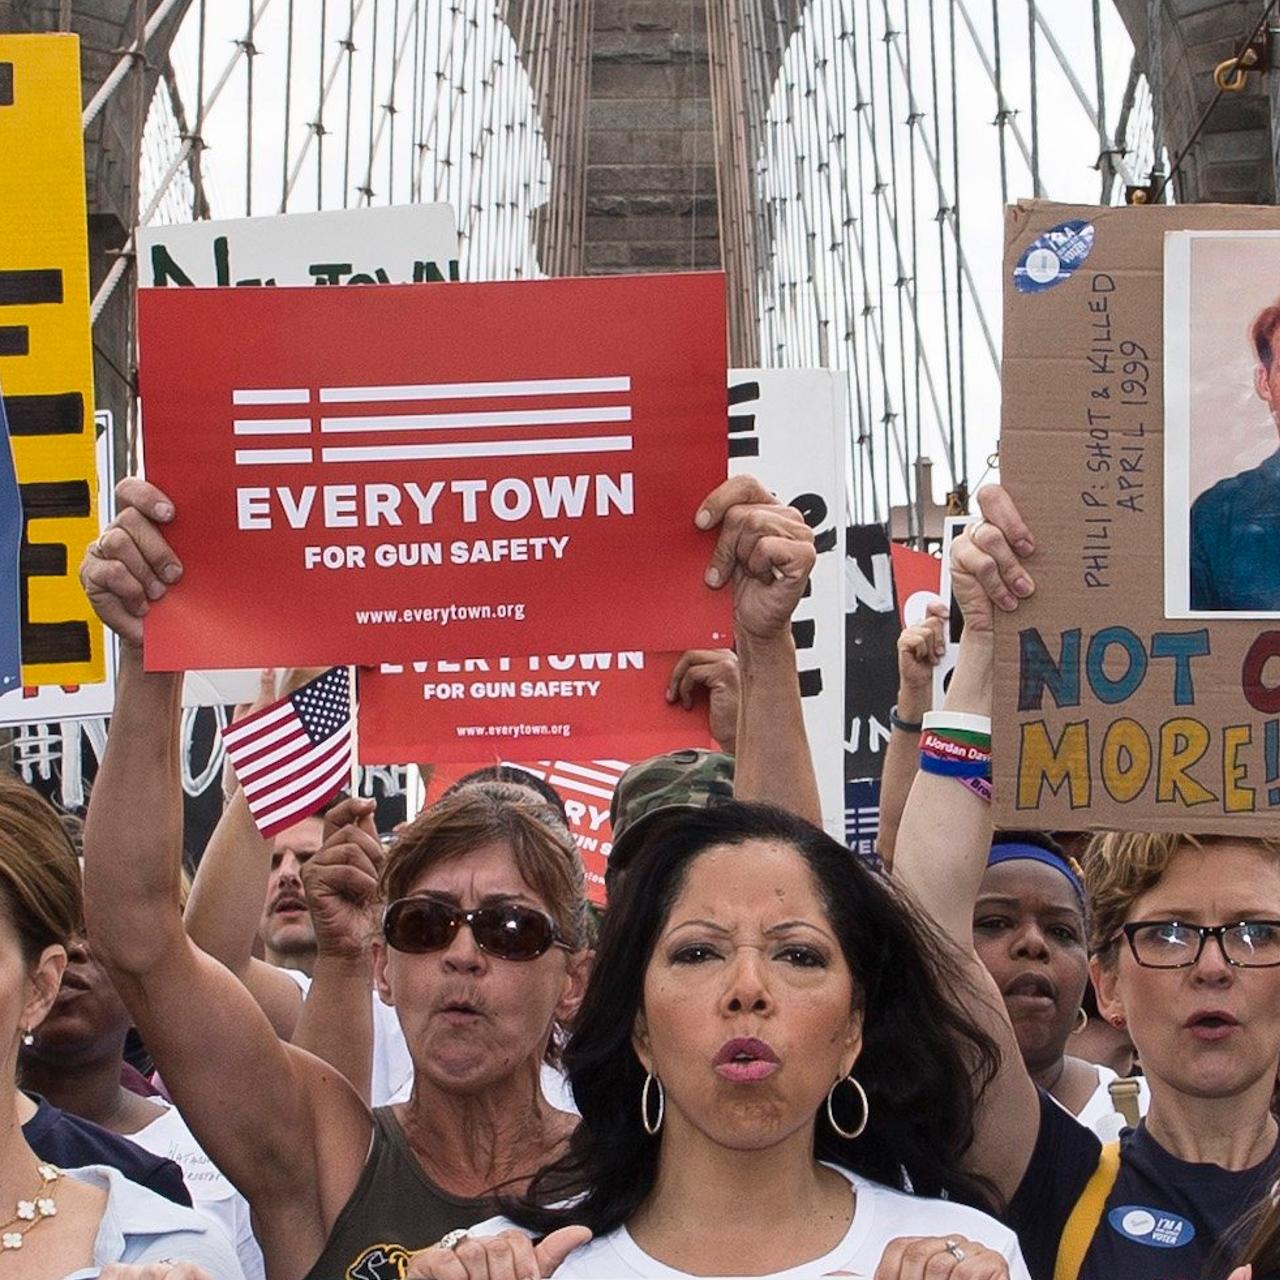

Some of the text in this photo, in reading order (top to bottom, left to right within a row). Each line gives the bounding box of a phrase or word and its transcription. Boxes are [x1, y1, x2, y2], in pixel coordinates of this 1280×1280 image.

[1085, 273, 1117, 374] KILLED
[1091, 387, 1111, 401] &
[1086, 408, 1112, 473] SHOT
[1117, 340, 1150, 513] APRIL 1999
[235, 472, 635, 531] EVERYTOWN
[304, 535, 570, 570] FOR GUN SAFETY
[355, 603, 526, 626] www.everytown.org
[423, 680, 602, 701] FOR GUN SAFETY
[1017, 626, 1211, 712] NOT
[456, 722, 571, 739] www.everytown.org
